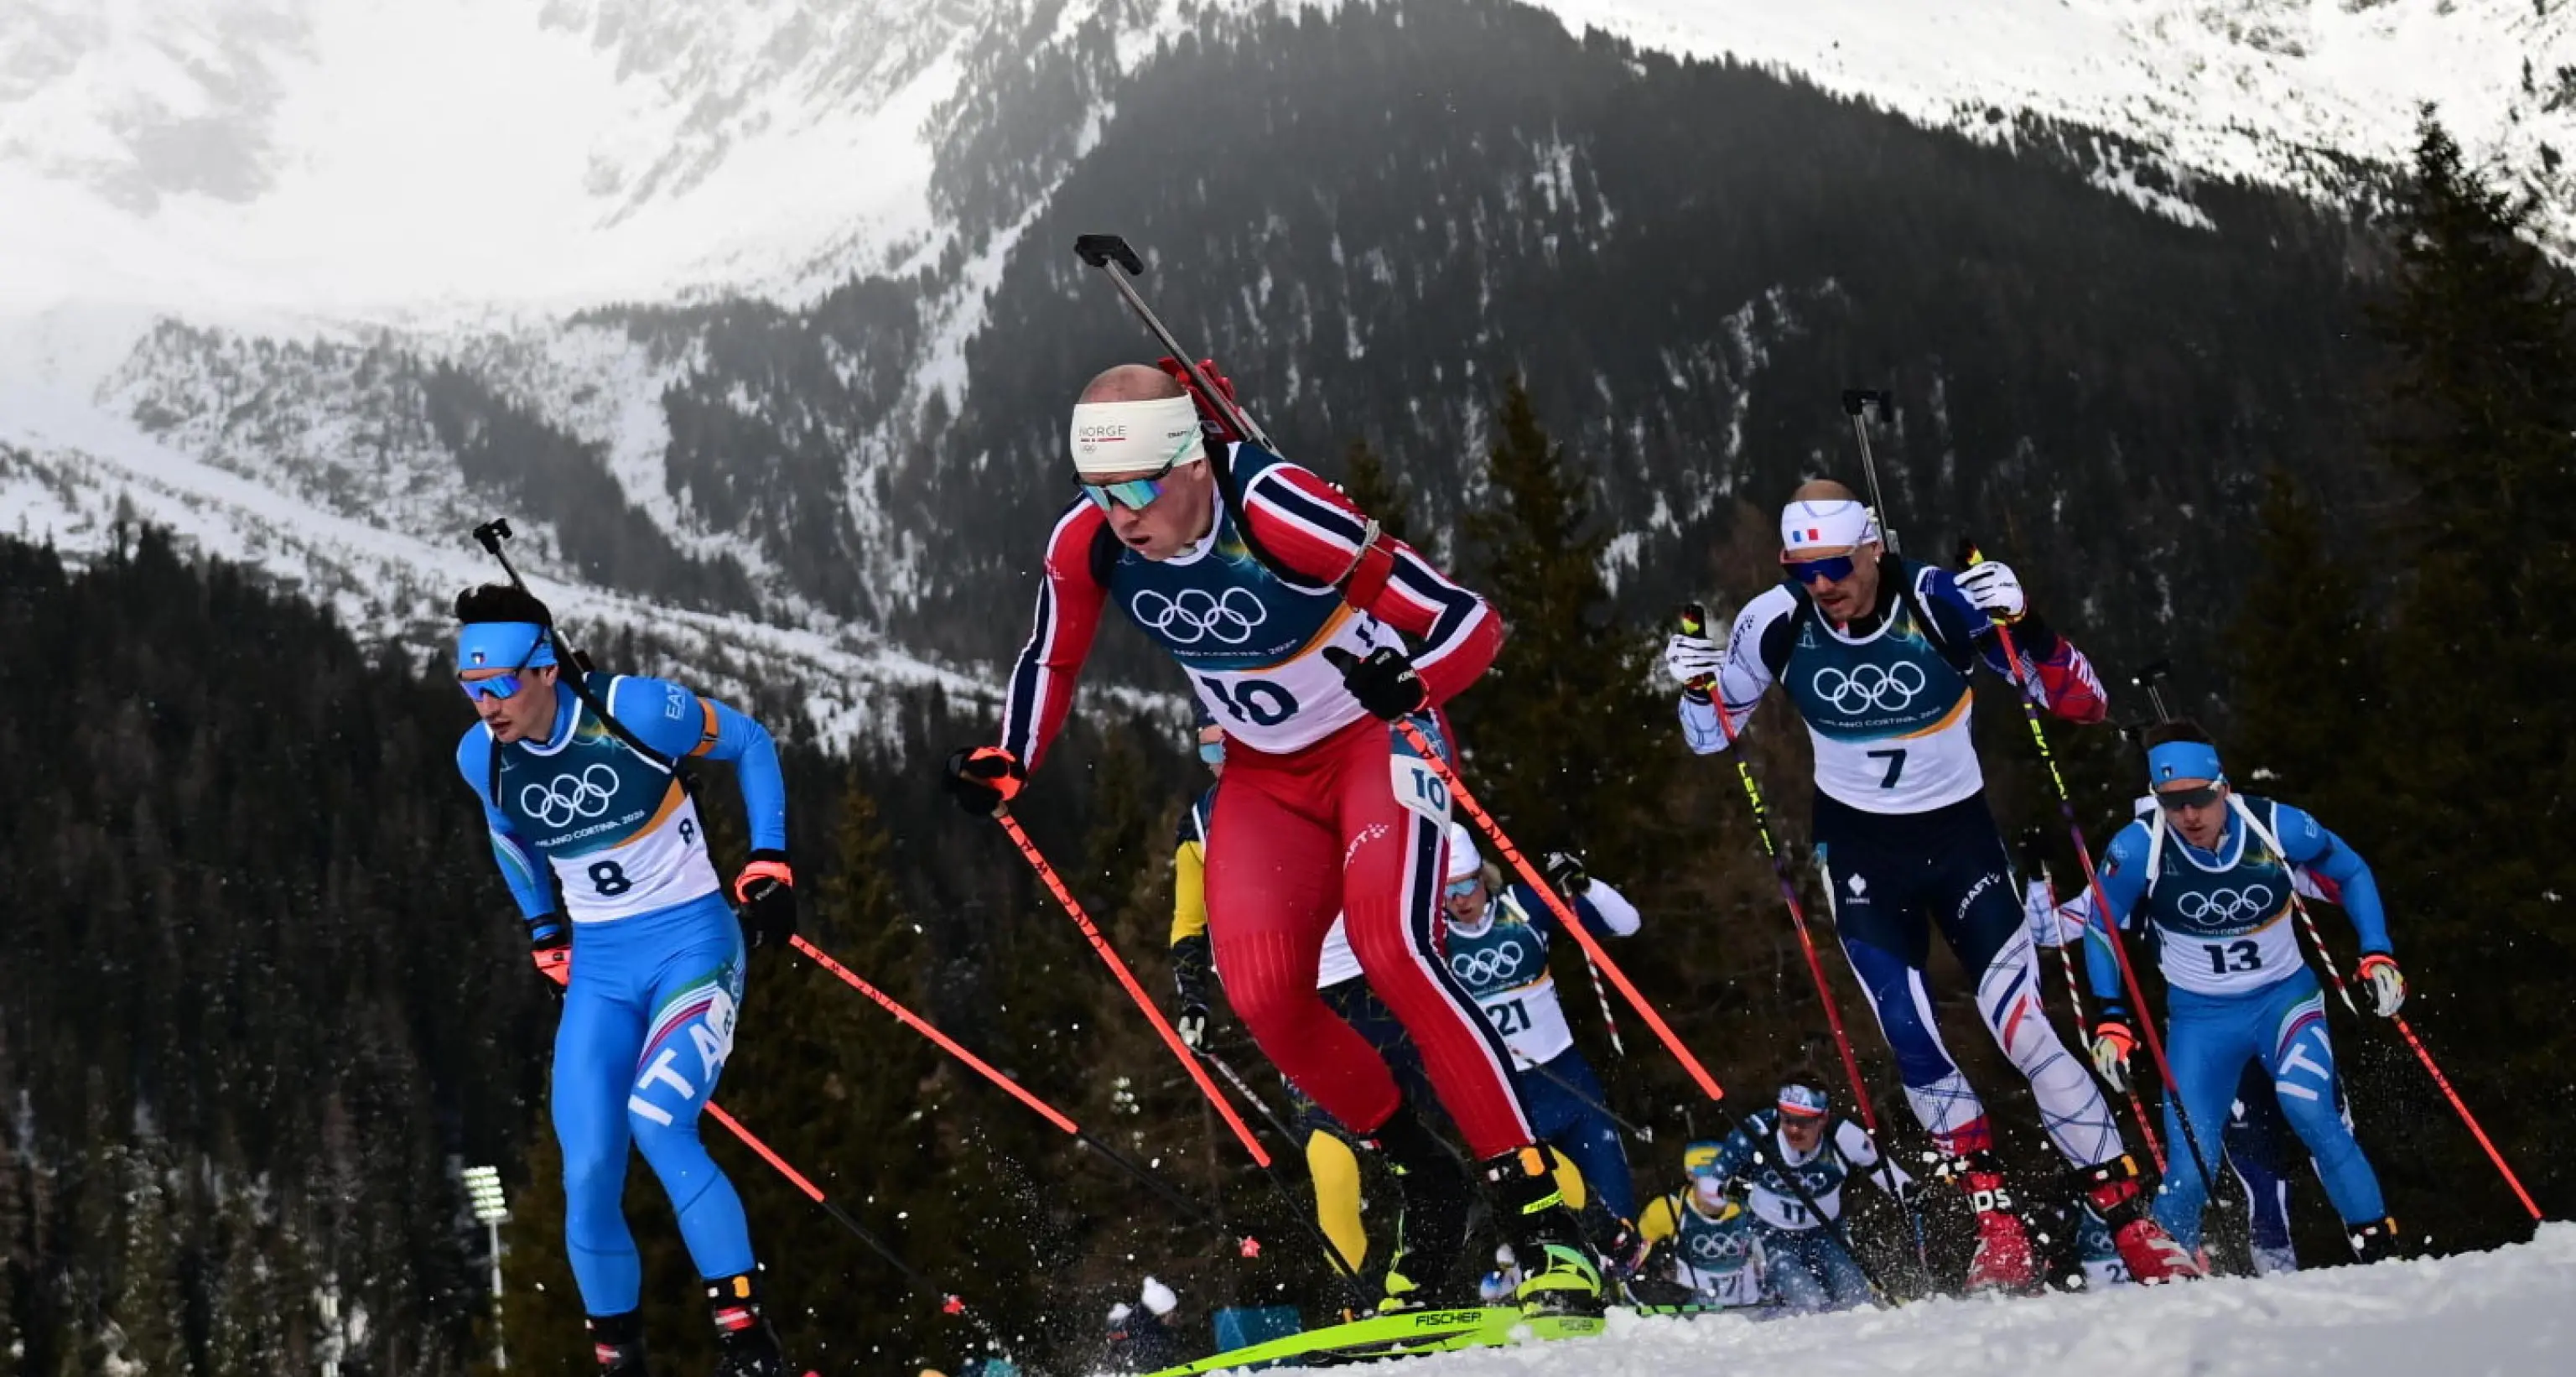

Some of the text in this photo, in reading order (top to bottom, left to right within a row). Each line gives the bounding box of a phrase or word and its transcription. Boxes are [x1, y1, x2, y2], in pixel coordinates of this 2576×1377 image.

[1078, 425, 1127, 437] NORGE
[1199, 675, 1300, 726] 10
[1867, 749, 1907, 788] 7
[1411, 767, 1446, 812] 10
[588, 860, 632, 896] 8
[2203, 938, 2262, 974] 13
[1486, 998, 1531, 1037] 21
[1779, 1199, 1806, 1224] 11
[2106, 1264, 2132, 1285] 2
[1415, 1311, 1483, 1328] FISCHER
